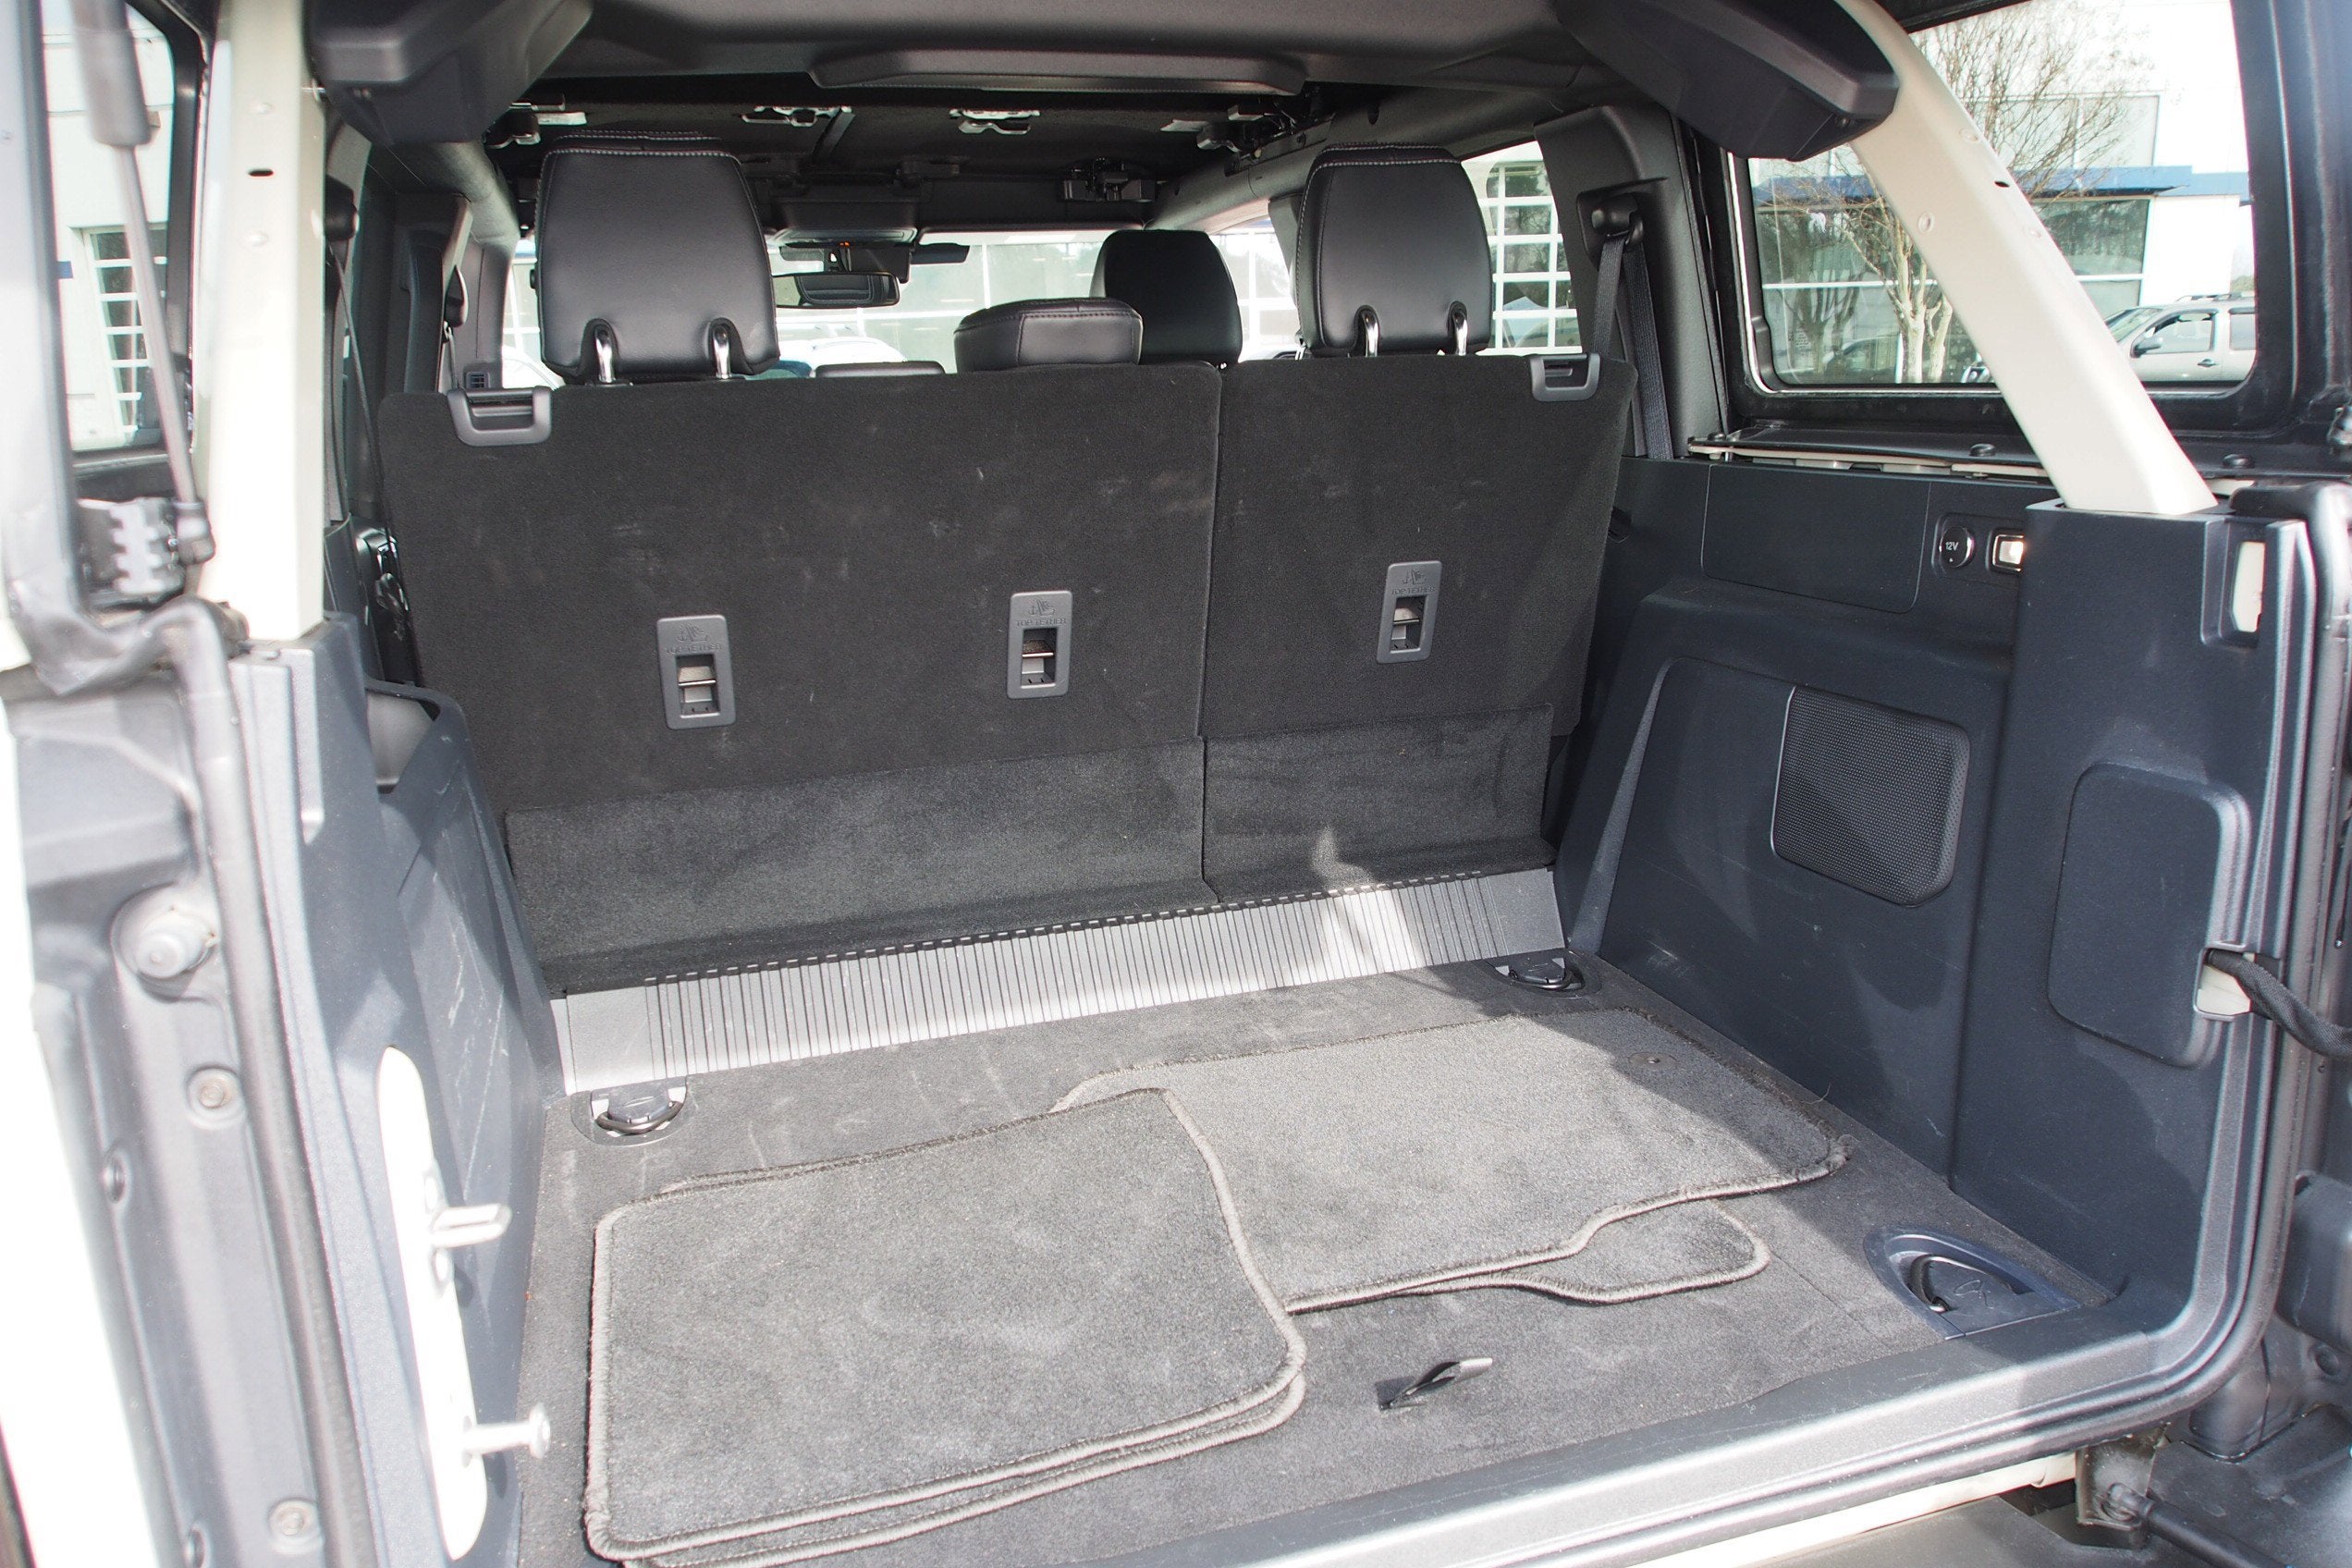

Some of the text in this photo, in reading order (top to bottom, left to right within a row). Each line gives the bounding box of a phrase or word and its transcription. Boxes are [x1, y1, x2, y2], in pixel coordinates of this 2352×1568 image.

[1945, 541, 1959, 551] 12V
[1015, 617, 1067, 627] TOP TETHER
